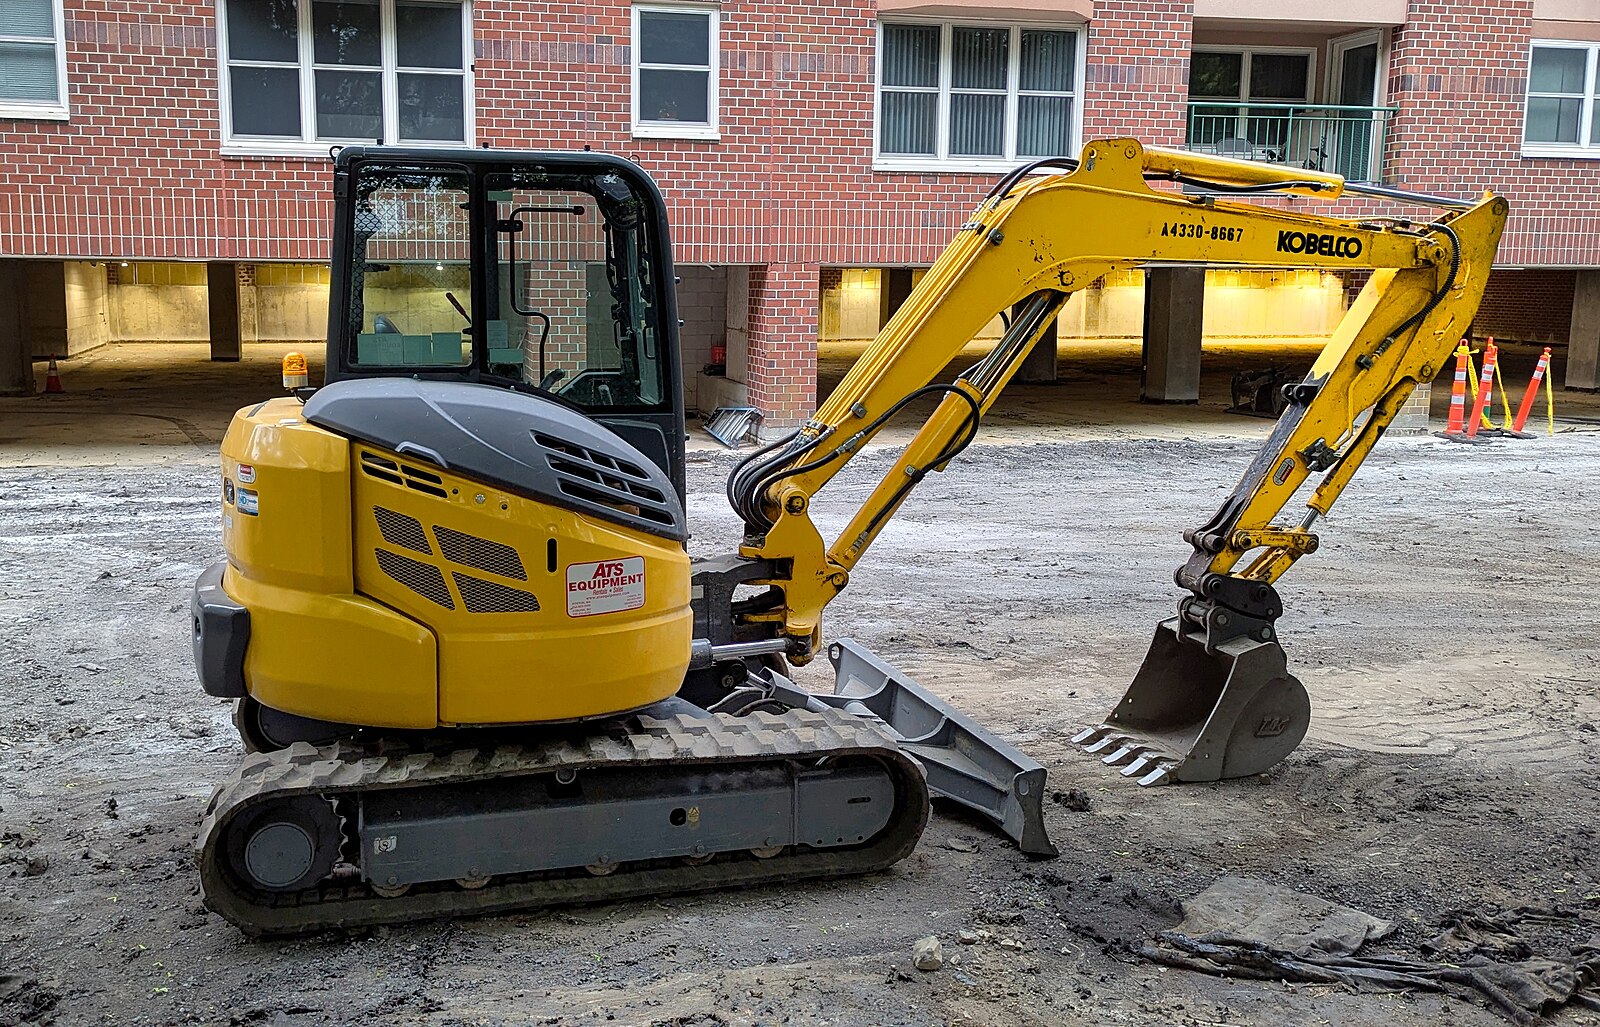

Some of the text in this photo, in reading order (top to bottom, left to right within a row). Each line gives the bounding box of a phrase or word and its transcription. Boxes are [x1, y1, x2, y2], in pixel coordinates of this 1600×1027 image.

[1161, 222, 1244, 243] A4330-8667
[1276, 230, 1363, 259] KOBELCO
[592, 562, 624, 579] ATS
[568, 574, 643, 592] EQUIPMENT
